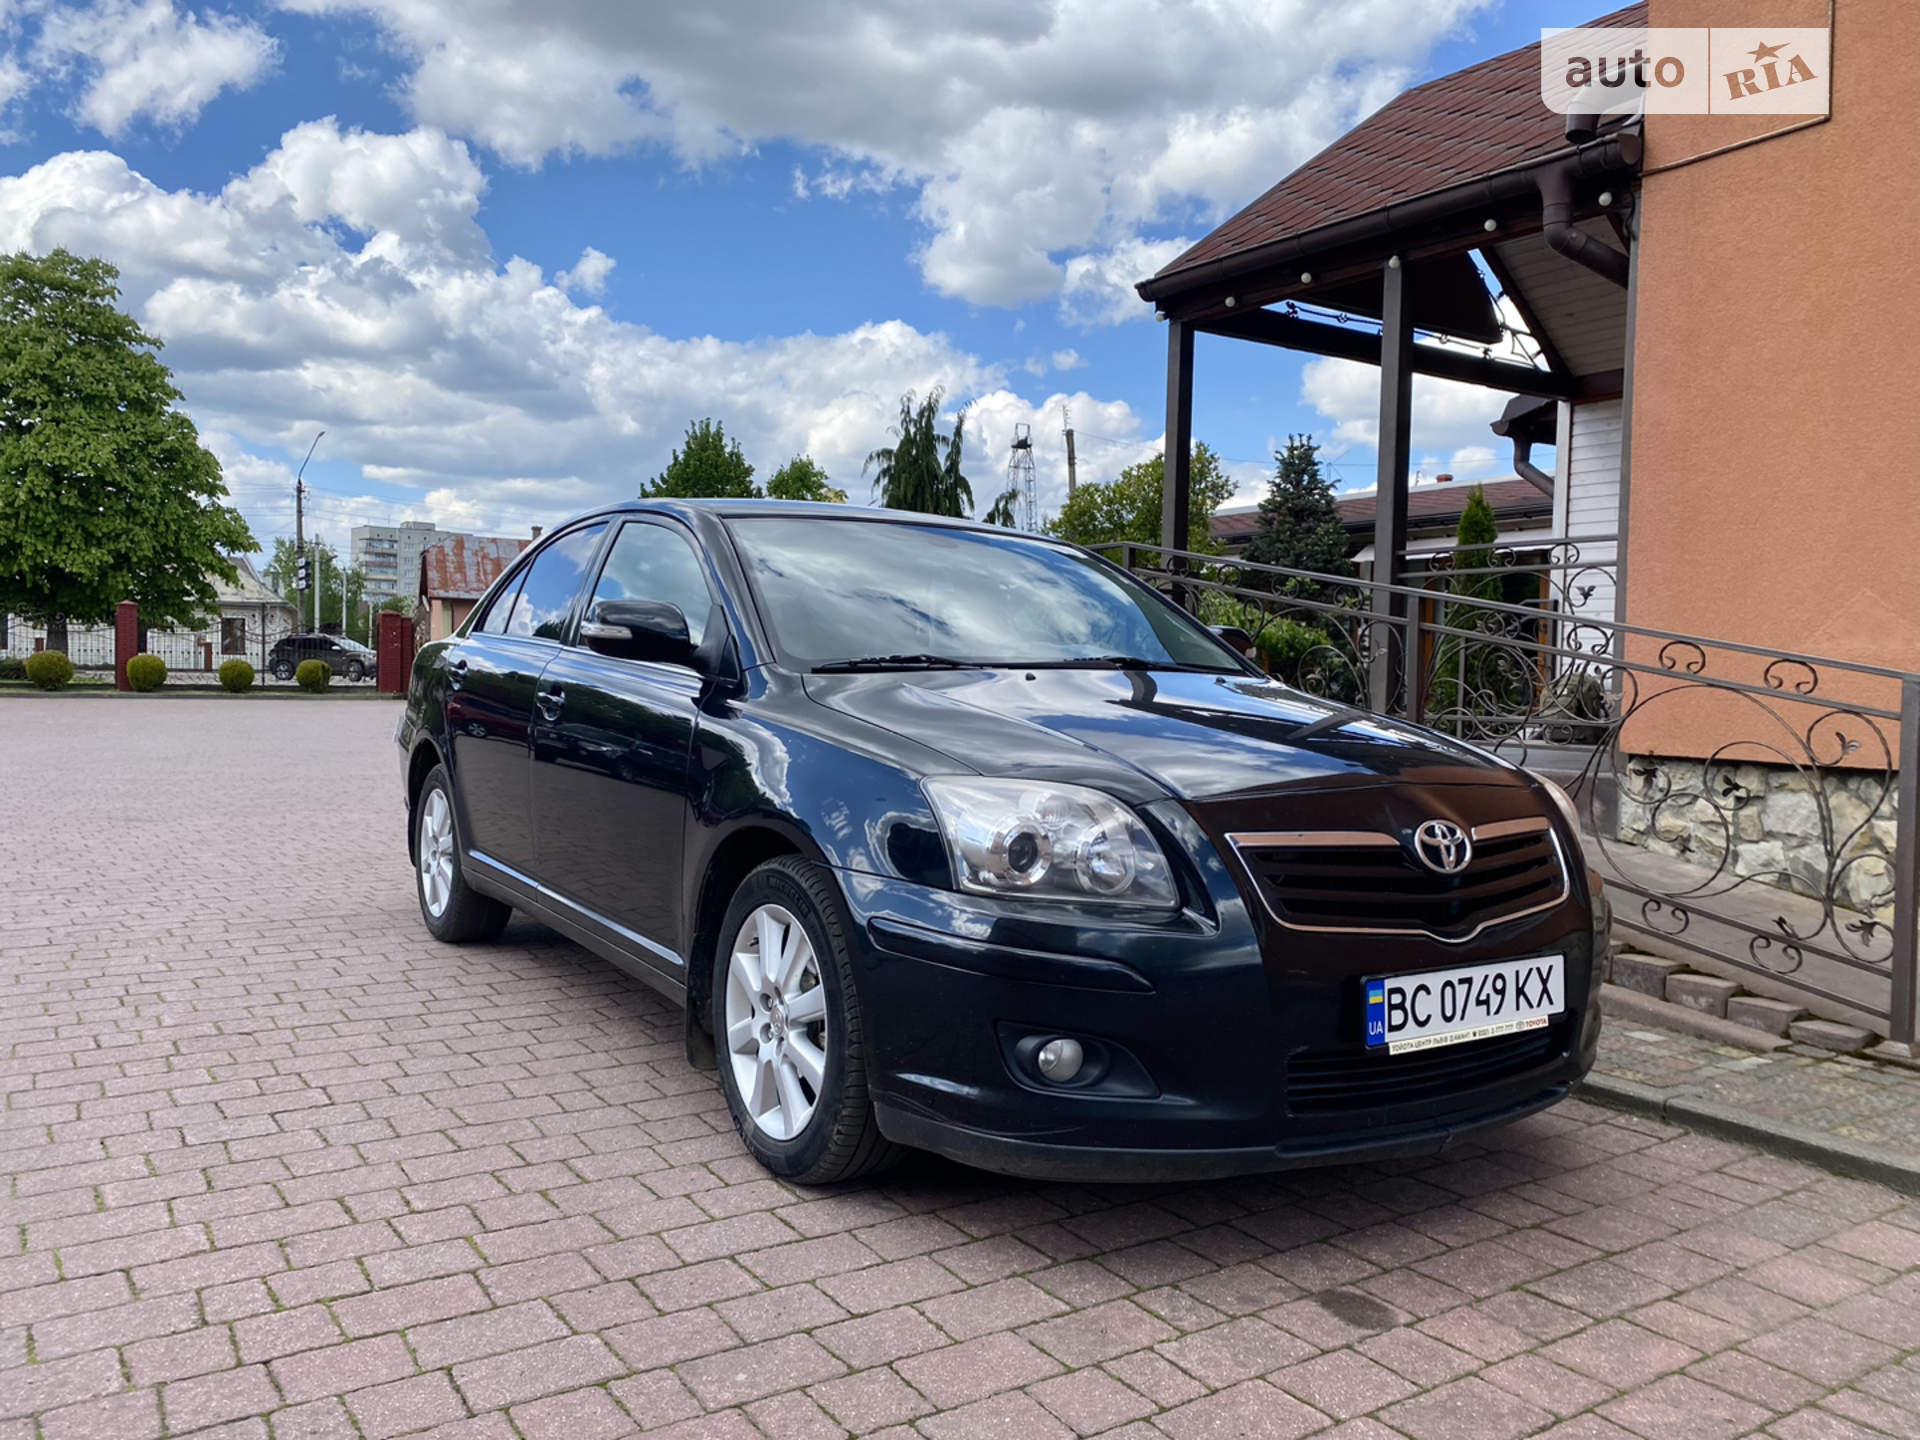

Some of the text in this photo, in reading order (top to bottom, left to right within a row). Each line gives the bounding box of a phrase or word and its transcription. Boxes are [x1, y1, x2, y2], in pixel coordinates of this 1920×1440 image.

[769, 877, 809, 917] MICHELIN
[1387, 965, 1554, 1033] BC 0749 KX
[1369, 1021, 1384, 1035] UA
[1525, 1018, 1547, 1027] TOYOTA
